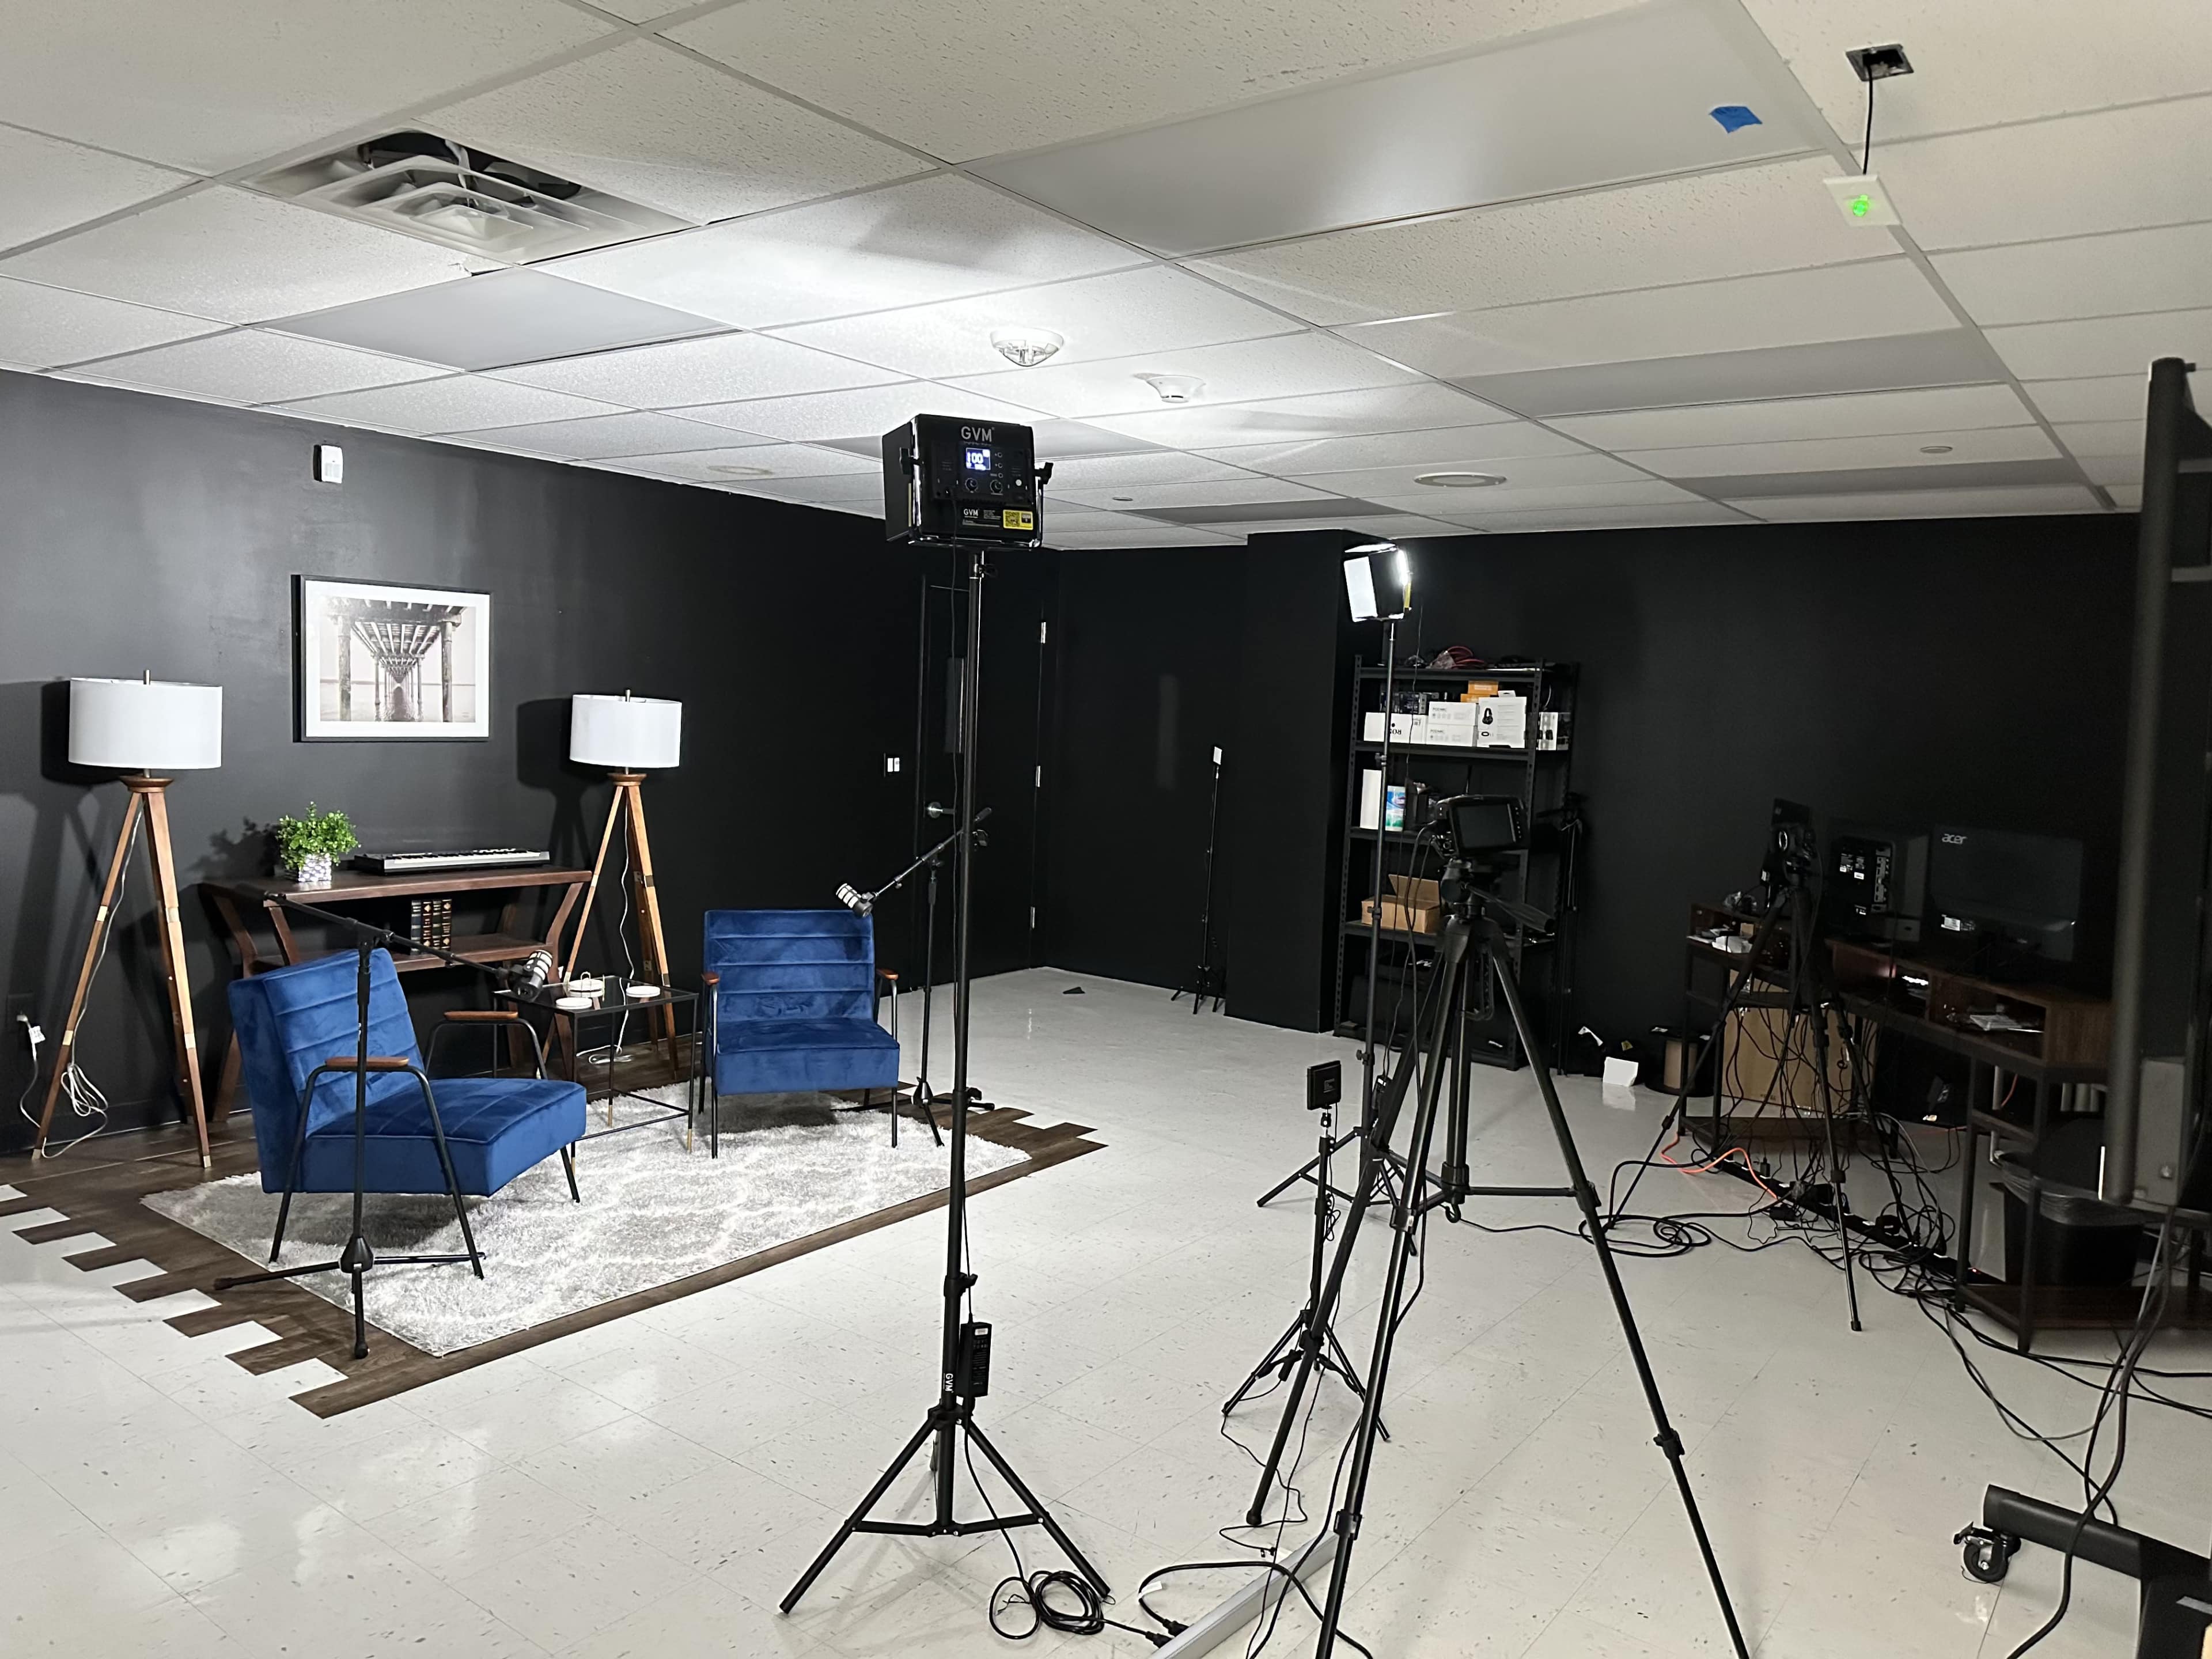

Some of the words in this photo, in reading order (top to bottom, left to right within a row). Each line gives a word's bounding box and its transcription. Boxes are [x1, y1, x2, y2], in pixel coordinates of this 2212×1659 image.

[961, 426, 992, 442] GVM
[963, 508, 979, 516] GVM
[1942, 834, 1968, 844] acer
[945, 1373, 954, 1392] GVM
